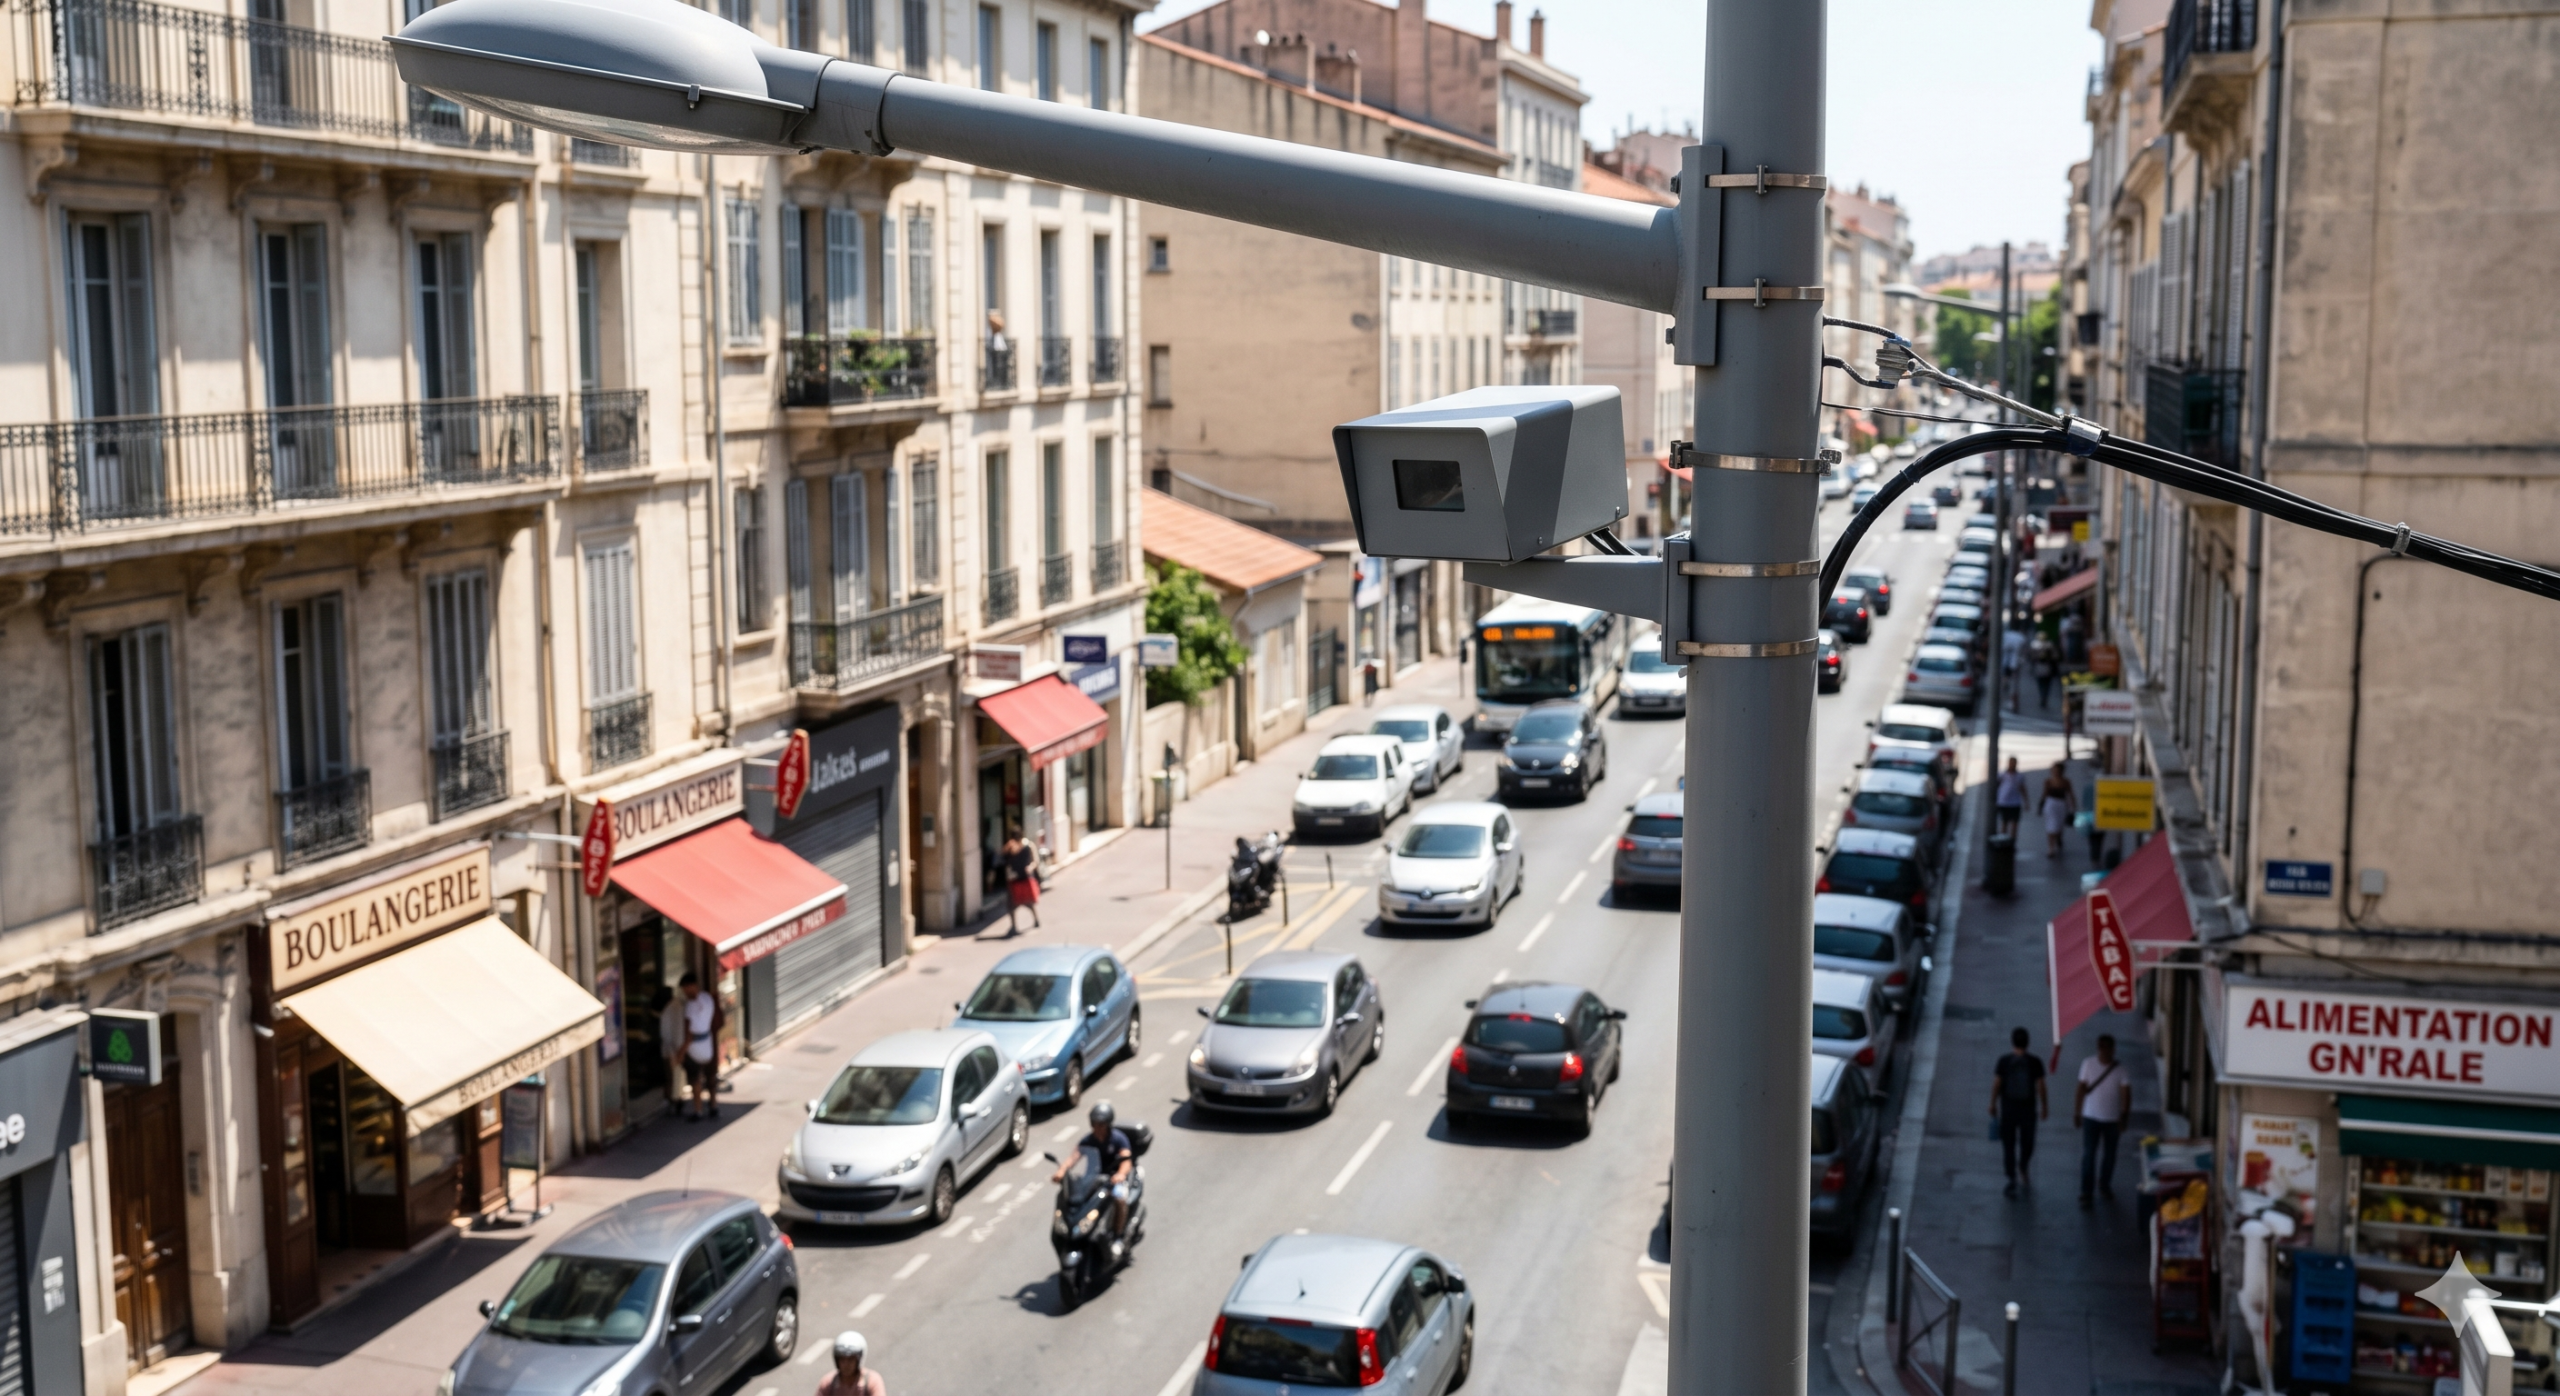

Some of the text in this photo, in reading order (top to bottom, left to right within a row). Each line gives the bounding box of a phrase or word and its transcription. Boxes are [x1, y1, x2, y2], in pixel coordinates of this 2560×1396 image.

[614, 768, 736, 842] BOULANGERIE
[284, 865, 481, 971] BOULANGERIE
[2094, 906, 2130, 1004] TABAC
[2246, 997, 2553, 1048] ALIMENTATION
[2308, 1041, 2484, 1084] GN'RALE
